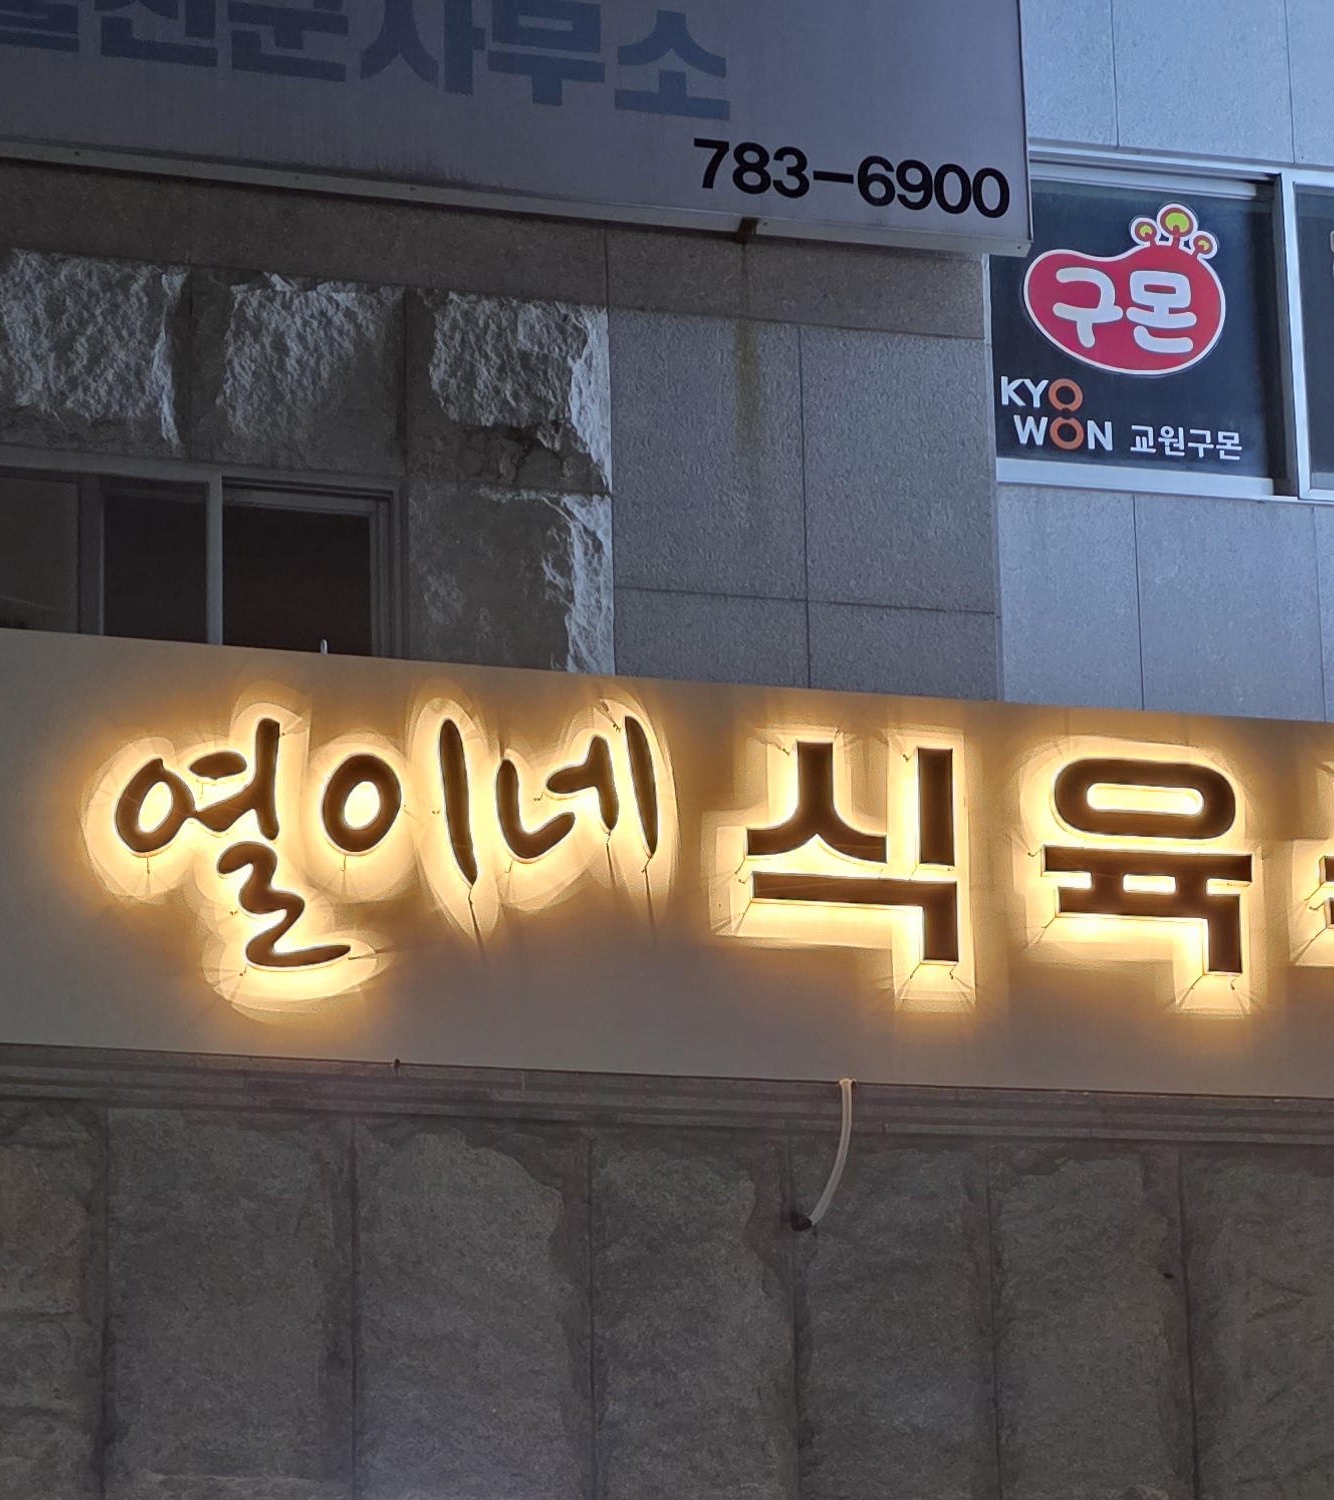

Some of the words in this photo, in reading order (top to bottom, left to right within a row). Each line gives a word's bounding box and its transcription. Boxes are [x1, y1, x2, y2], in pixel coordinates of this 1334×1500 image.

[693, 137, 1010, 219] 783-6900
[1052, 265, 1197, 354] 구몬
[1001, 376, 1083, 411] KYO
[1013, 414, 1113, 452] WON
[1130, 424, 1243, 461] 교원구몬
[115, 715, 659, 970] 열이네
